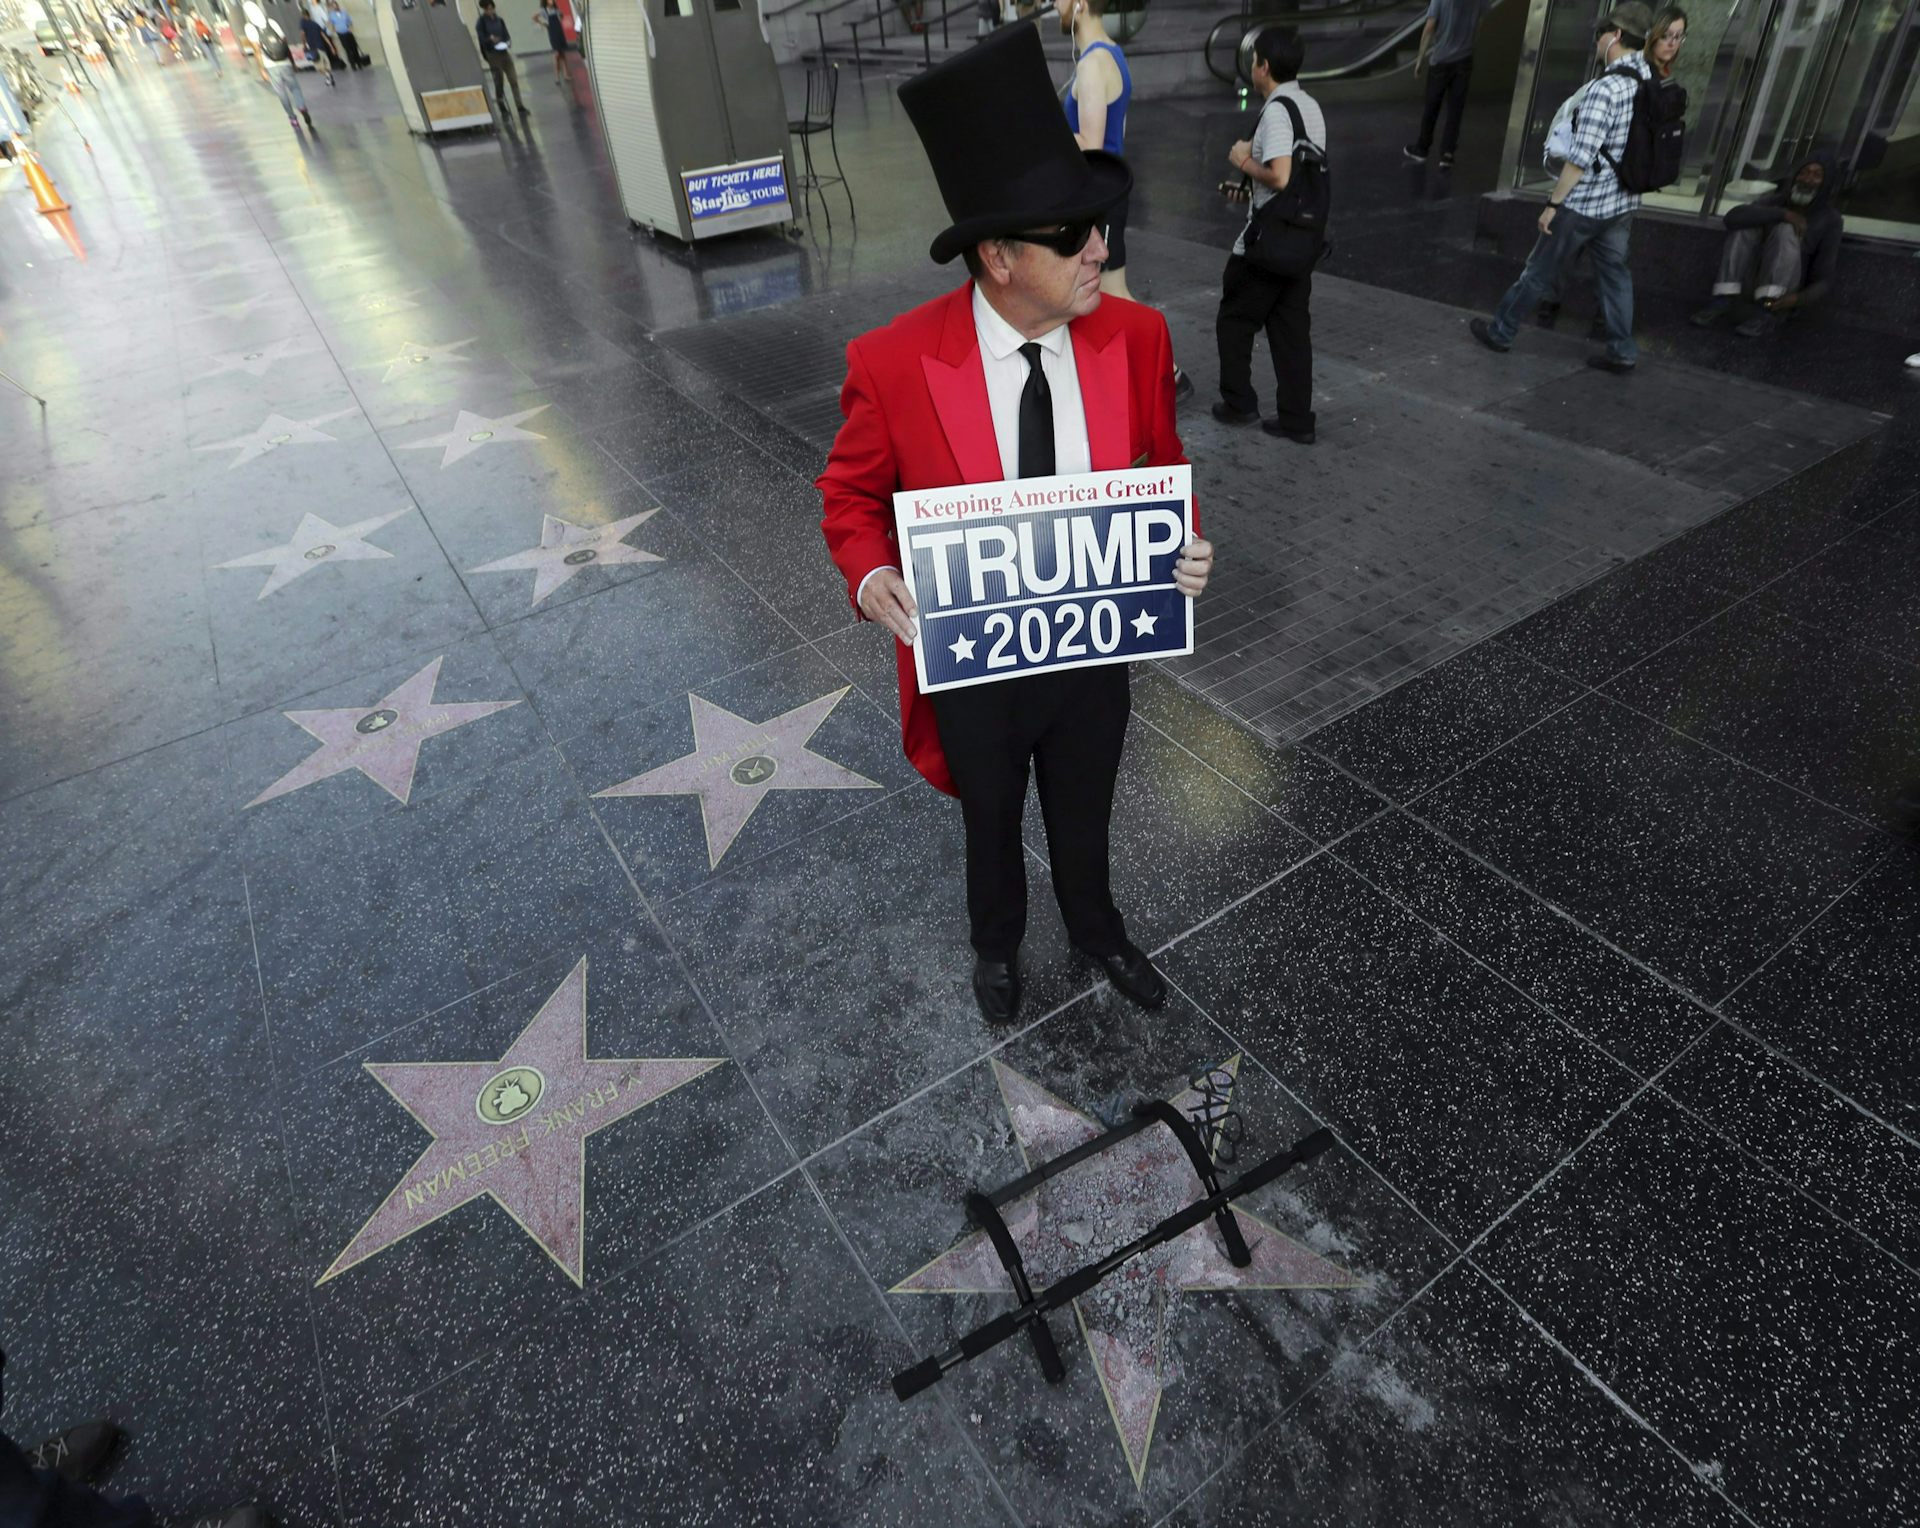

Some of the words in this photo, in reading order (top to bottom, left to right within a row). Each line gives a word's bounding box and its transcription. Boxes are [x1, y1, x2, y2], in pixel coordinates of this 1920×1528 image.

[688, 178, 708, 192] BUY
[711, 170, 750, 188] TICKETS
[752, 164, 781, 180] HERE!
[751, 185, 785, 200] TOURS
[914, 494, 1003, 519] Keeping
[1008, 483, 1098, 508] America
[1105, 476, 1174, 499] Great!
[911, 509, 1183, 607] TRUMP
[983, 599, 1122, 669] 2020
[540, 1080, 619, 1136] FRANK
[404, 1125, 531, 1210] FREEMAN
